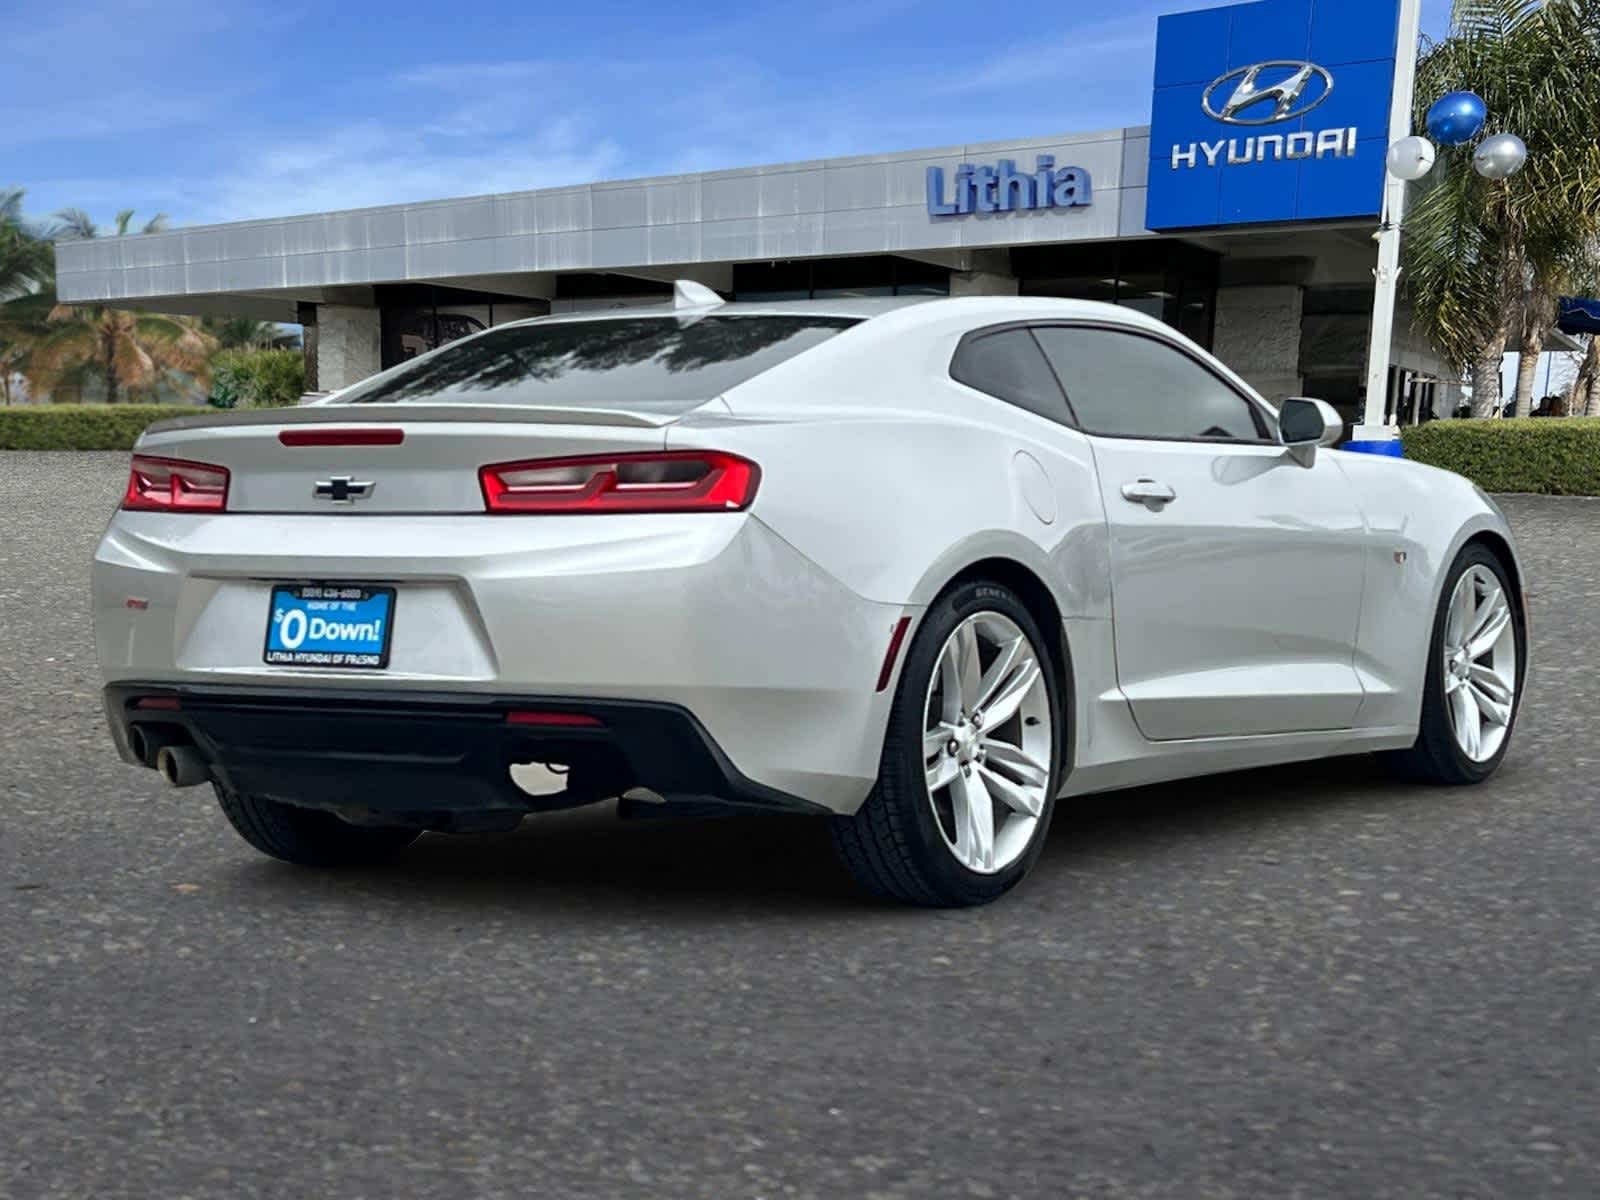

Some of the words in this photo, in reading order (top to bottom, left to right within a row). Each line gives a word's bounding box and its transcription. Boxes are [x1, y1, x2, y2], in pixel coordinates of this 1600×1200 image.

[1171, 127, 1357, 169] HYUNDAI
[926, 154, 1093, 217] Lithia
[308, 617, 381, 641] Down!
[266, 651, 293, 662] LITHIA
[294, 652, 332, 664] HYUNDAI
[333, 654, 345, 664] OF
[345, 654, 380, 666] FRESNO
